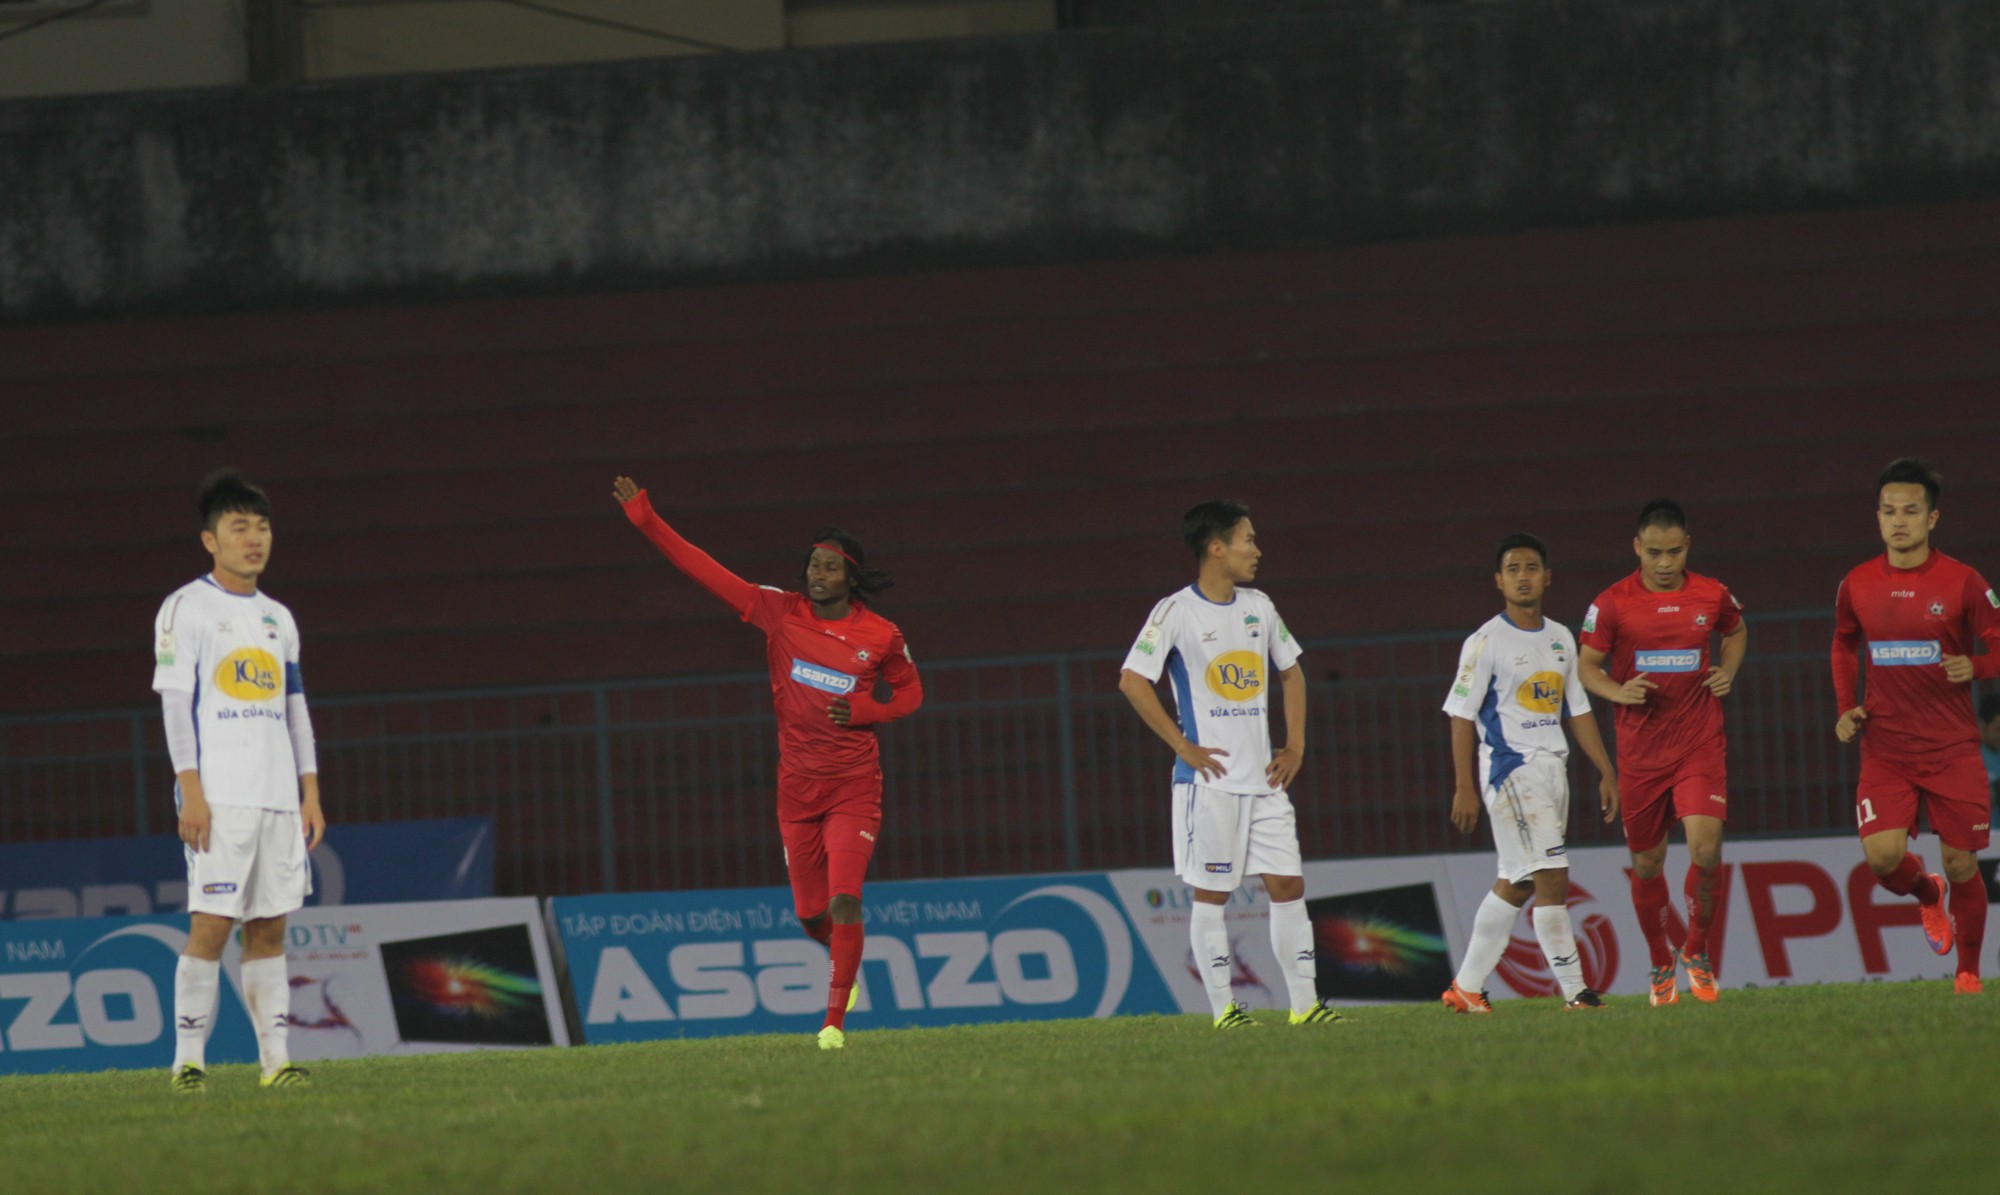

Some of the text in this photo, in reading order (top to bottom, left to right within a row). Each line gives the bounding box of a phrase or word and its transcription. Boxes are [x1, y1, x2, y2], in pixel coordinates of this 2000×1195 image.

[1891, 589, 1916, 598] mitre
[1657, 605, 1681, 613] mitre
[233, 659, 262, 689] IQ
[1218, 663, 1246, 689] IQ
[1239, 667, 1257, 678] Lac
[1244, 679, 1260, 687] Pro
[563, 912, 605, 940] TẬP
[610, 907, 684, 936] ĐOÀN
[688, 906, 743, 935] ĐIỆN
[875, 899, 920, 926] VIỆT
[924, 900, 982, 921] NAM
[6, 938, 66, 961] NAM
